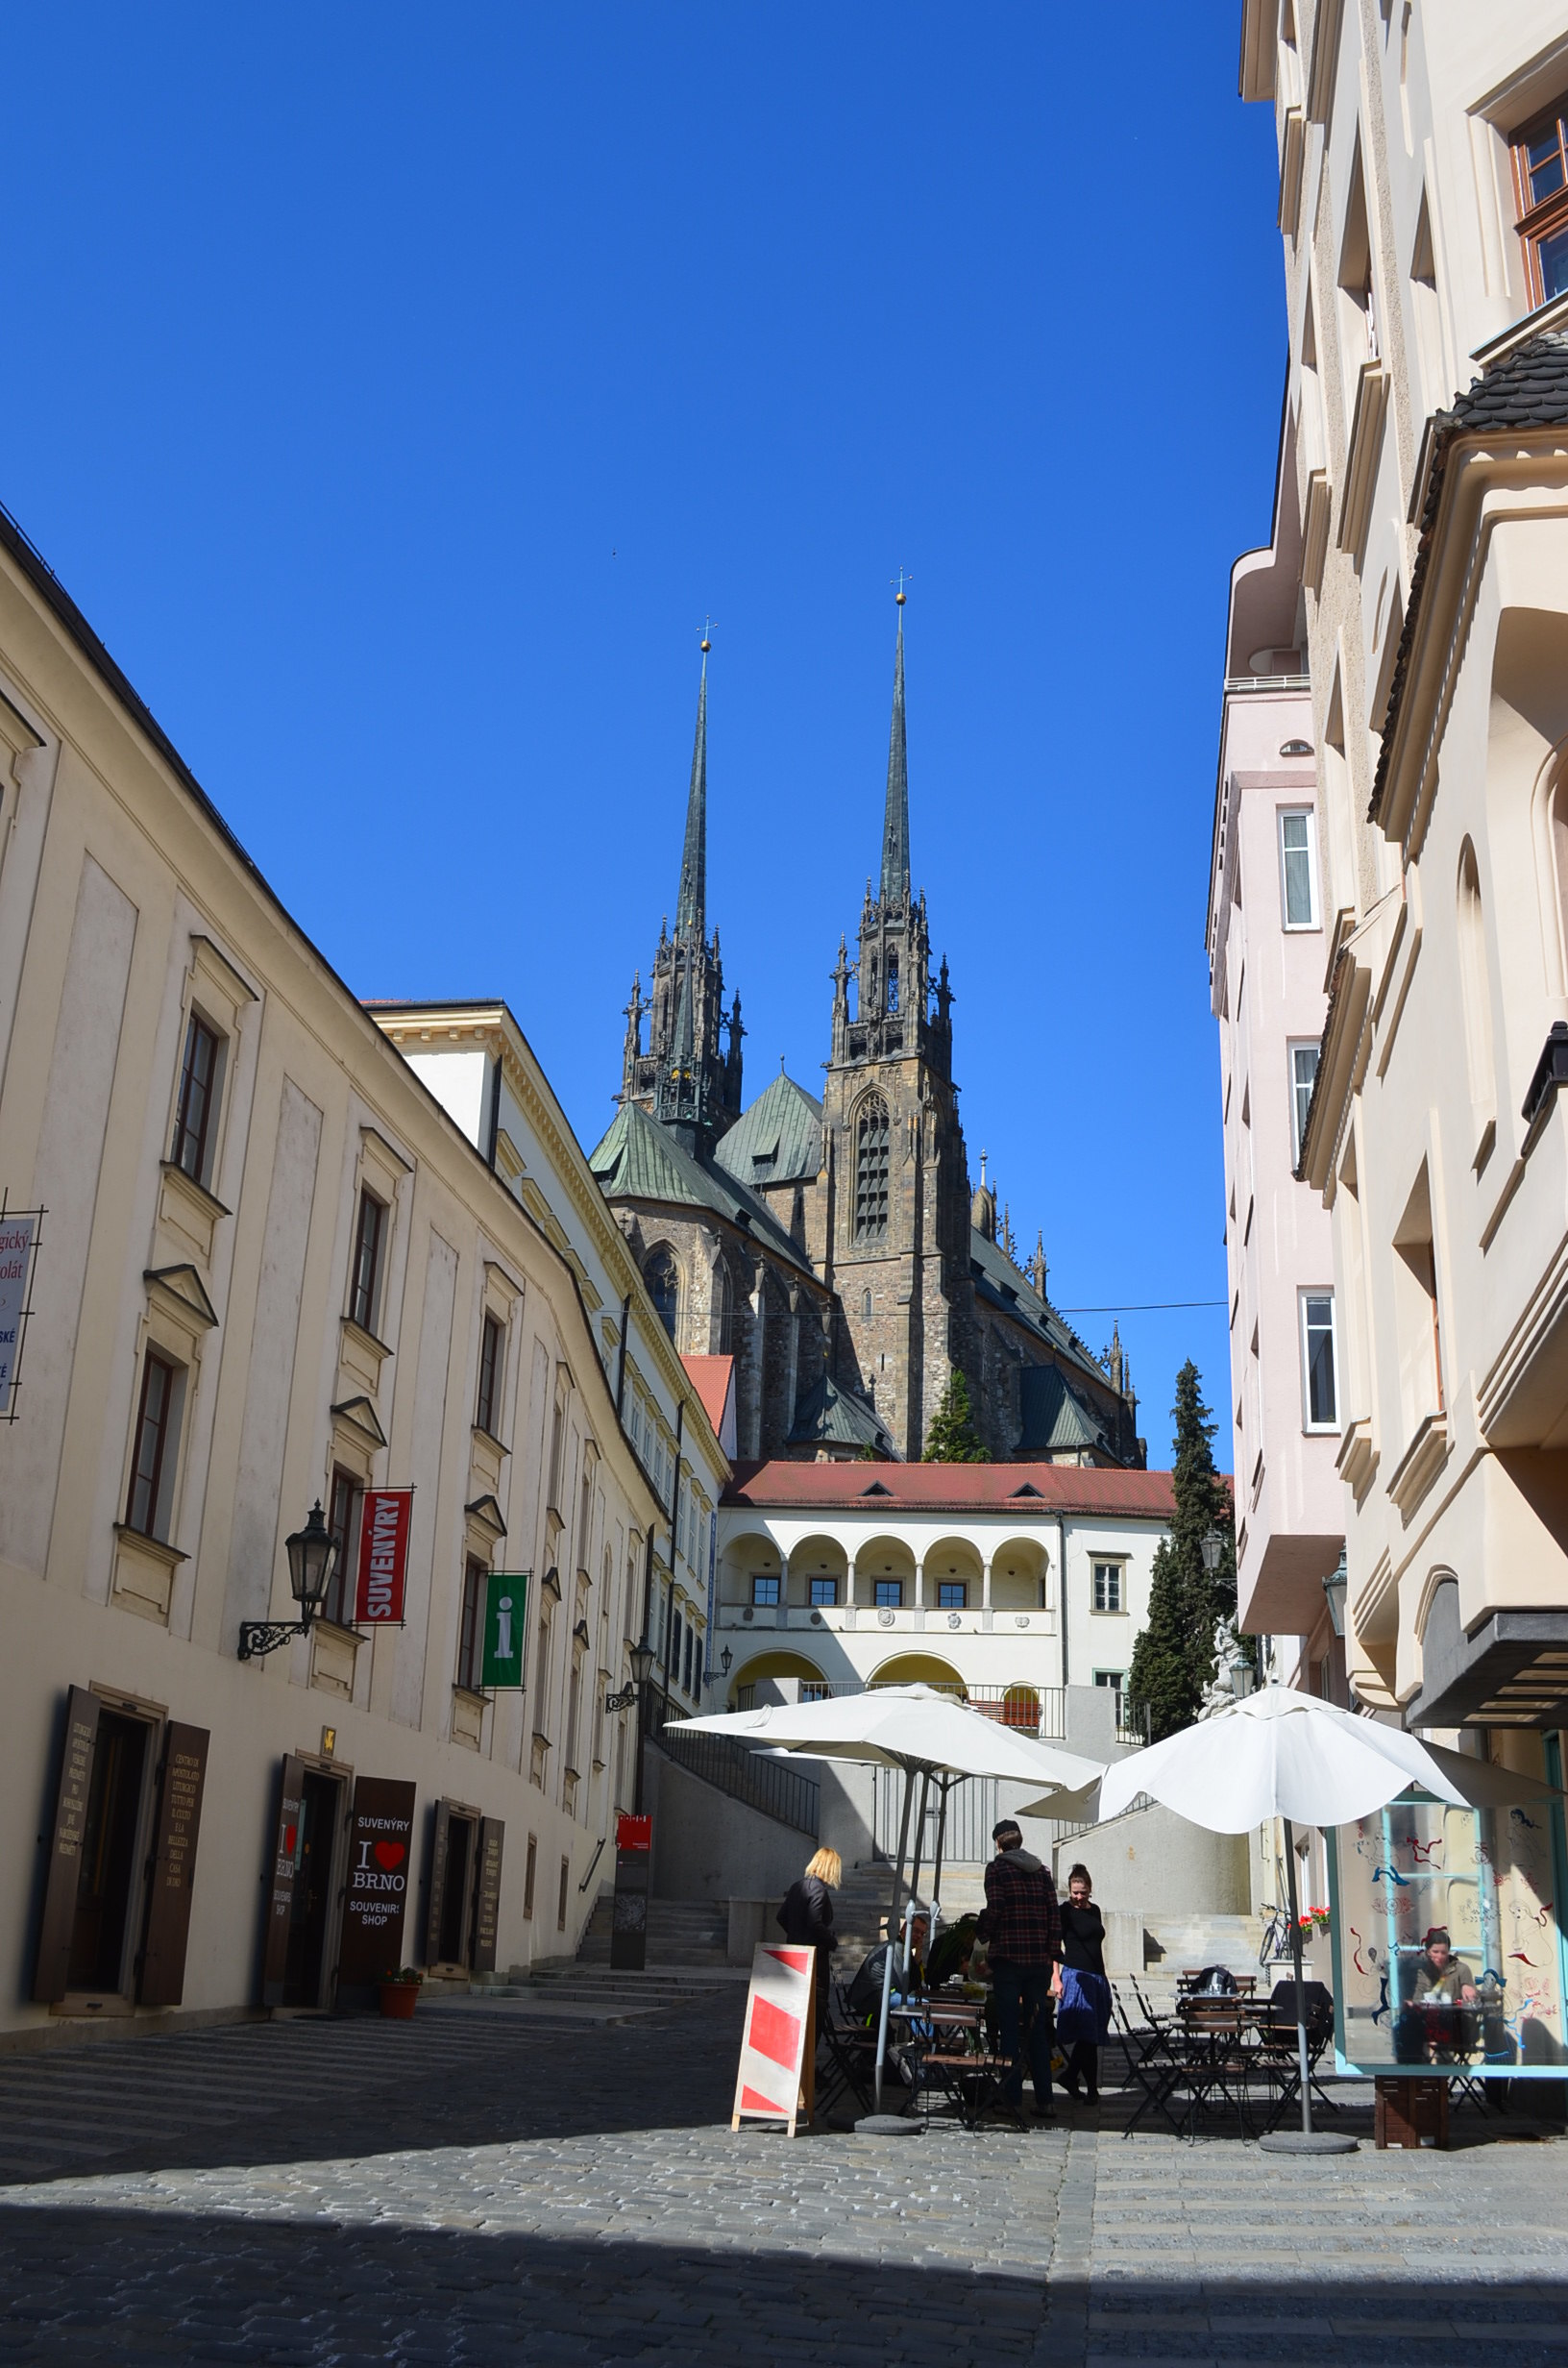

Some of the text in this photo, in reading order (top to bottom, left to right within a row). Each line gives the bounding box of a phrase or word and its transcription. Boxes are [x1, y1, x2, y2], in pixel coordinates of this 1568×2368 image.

[367, 1497, 400, 1617] SUVENÝRY
[357, 1816, 409, 1832] SUVENÝRY
[280, 1824, 286, 1853] I
[356, 1840, 373, 1869] I
[277, 1859, 293, 1878] BRNO
[352, 1872, 404, 1891] BRNO
[361, 1914, 388, 1926] SHOP
